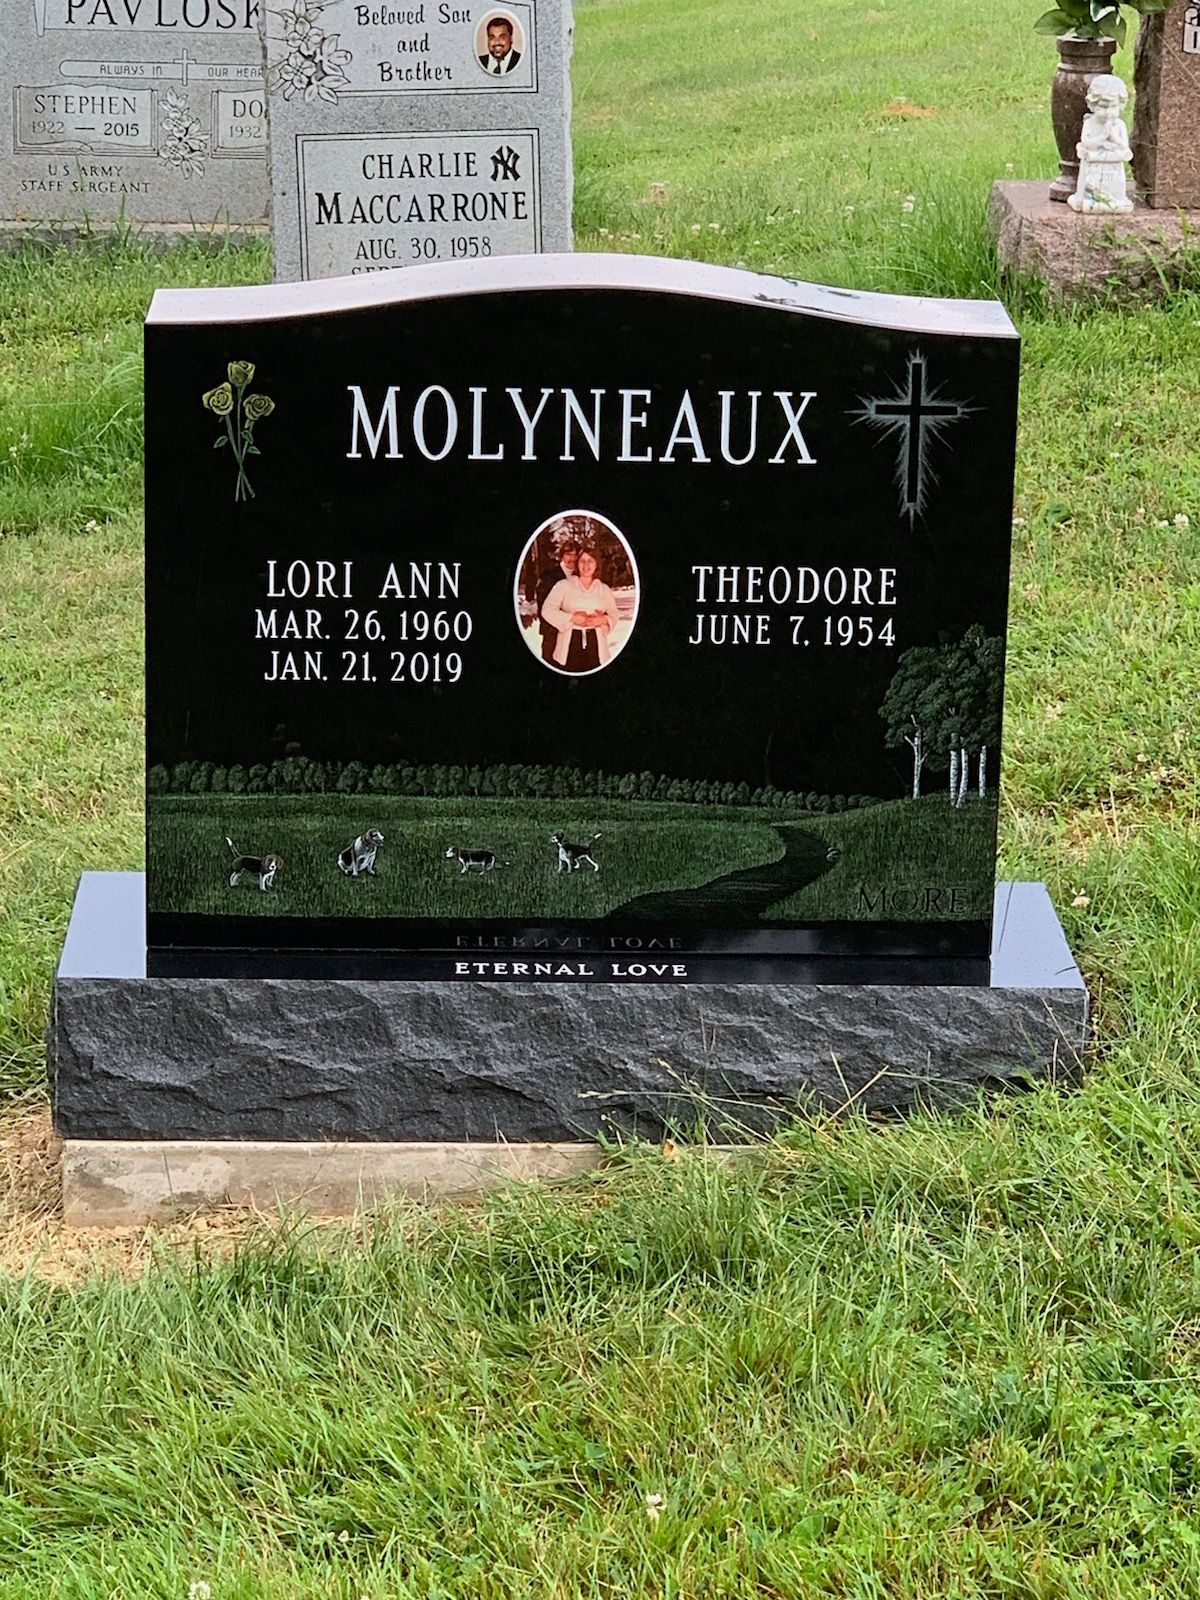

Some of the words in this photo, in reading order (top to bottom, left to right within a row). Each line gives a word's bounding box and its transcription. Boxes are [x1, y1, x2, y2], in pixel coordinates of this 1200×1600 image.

[354, 4, 425, 26] Beloved
[438, 3, 472, 24] Son
[397, 32, 431, 53] and
[100, 64, 145, 76] ALWAYS
[207, 66, 229, 78] OUR
[377, 61, 453, 82] Brother
[34, 94, 137, 115] STEPHEN
[32, 121, 65, 134] 1922
[104, 122, 140, 137] 2015
[229, 125, 262, 139] 1932
[79, 165, 123, 177] ARMY
[362, 152, 478, 180] CHARLIE
[21, 180, 63, 192] STAFF
[354, 238, 402, 260] AUG.
[451, 236, 492, 258] 1958
[346, 384, 818, 466] MOLYNEAUX
[266, 559, 353, 599] LORI
[378, 562, 462, 599] ANN
[691, 565, 897, 606] THEODORE
[254, 608, 331, 640] MAR.
[399, 610, 473, 642] 1960
[688, 614, 771, 645] JUNE
[823, 615, 896, 647] 1954
[264, 650, 328, 682] JAN.
[390, 651, 463, 683] 2019
[857, 887, 967, 914] MORE
[454, 962, 594, 976] ETERNAL
[611, 963, 688, 977] LOVE
